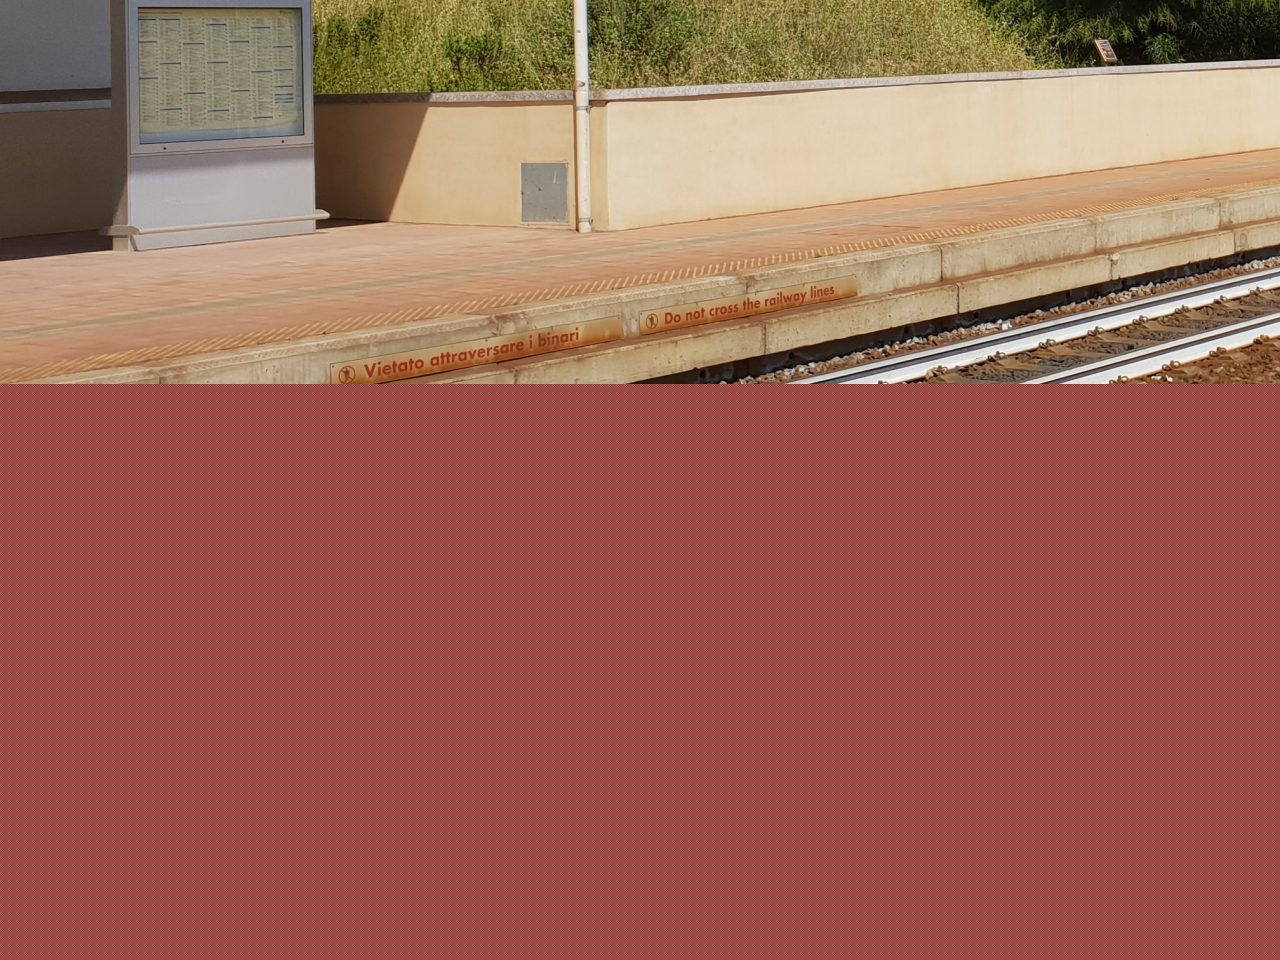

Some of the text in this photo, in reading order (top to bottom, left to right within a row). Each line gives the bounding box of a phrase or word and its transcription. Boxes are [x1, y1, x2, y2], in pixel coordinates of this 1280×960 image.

[664, 285, 835, 325] Do not cross the railway lines
[364, 357, 425, 378] Vietato
[430, 341, 525, 367] attraversare
[538, 327, 580, 347] binari
